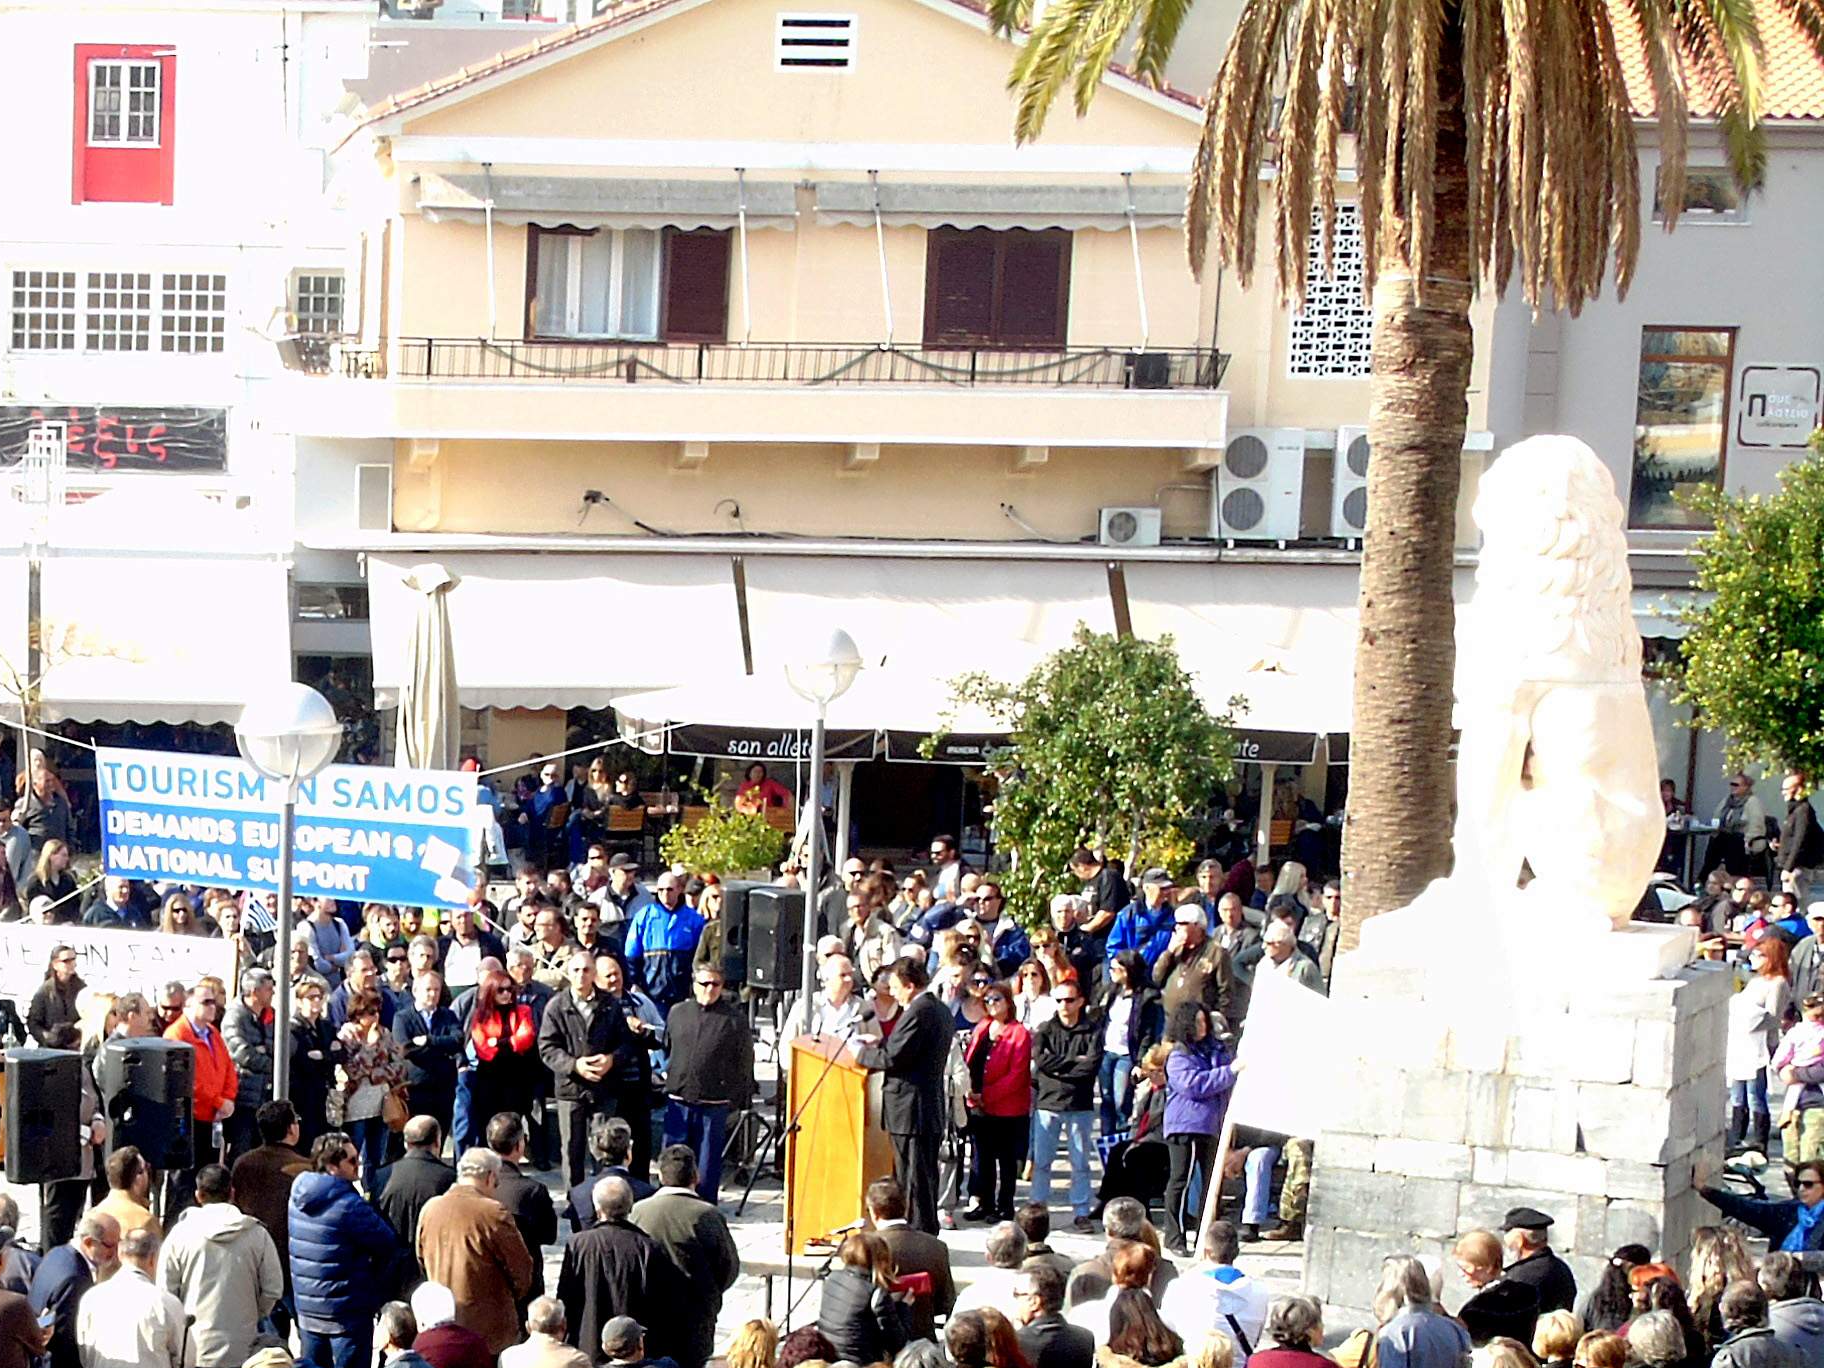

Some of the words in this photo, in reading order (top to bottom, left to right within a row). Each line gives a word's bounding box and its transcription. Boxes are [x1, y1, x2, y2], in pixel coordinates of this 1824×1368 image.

[728, 739, 762, 755] san
[103, 762, 266, 802] TOURISM
[332, 777, 465, 817] SAMOS
[107, 809, 237, 846] DEMANDS
[242, 819, 392, 859] EUOPEAN
[108, 844, 243, 881] NATIONAL
